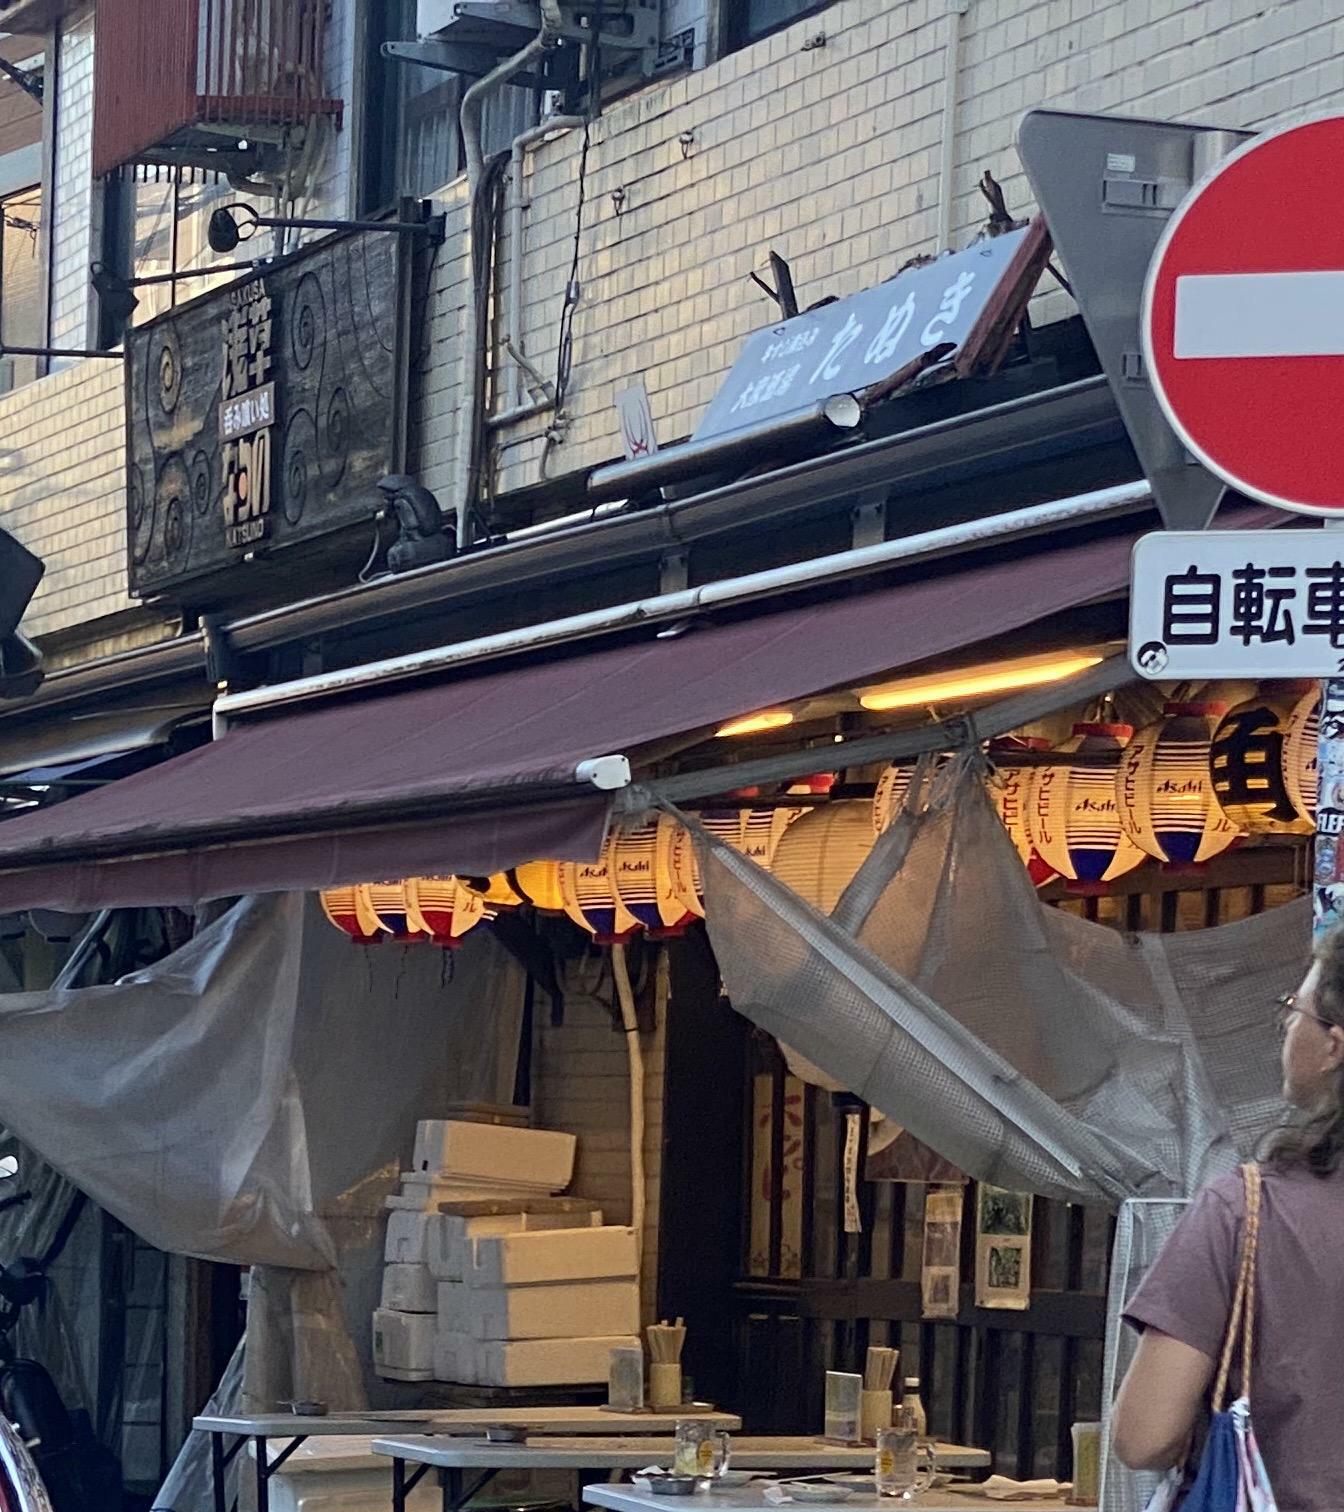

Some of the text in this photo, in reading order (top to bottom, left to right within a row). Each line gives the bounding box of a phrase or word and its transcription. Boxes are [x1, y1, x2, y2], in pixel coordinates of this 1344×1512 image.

[809, 271, 975, 385] たぬき
[1163, 560, 1344, 650] 自転車
[1002, 768, 1021, 838] アサヒビー
[1037, 766, 1056, 844] サヒビール
[1075, 797, 1116, 812] Asah
[1124, 744, 1145, 835] アサヒビール
[1156, 778, 1203, 794] Asahi
[579, 865, 609, 879] Asah
[671, 829, 688, 894] サヒビール
